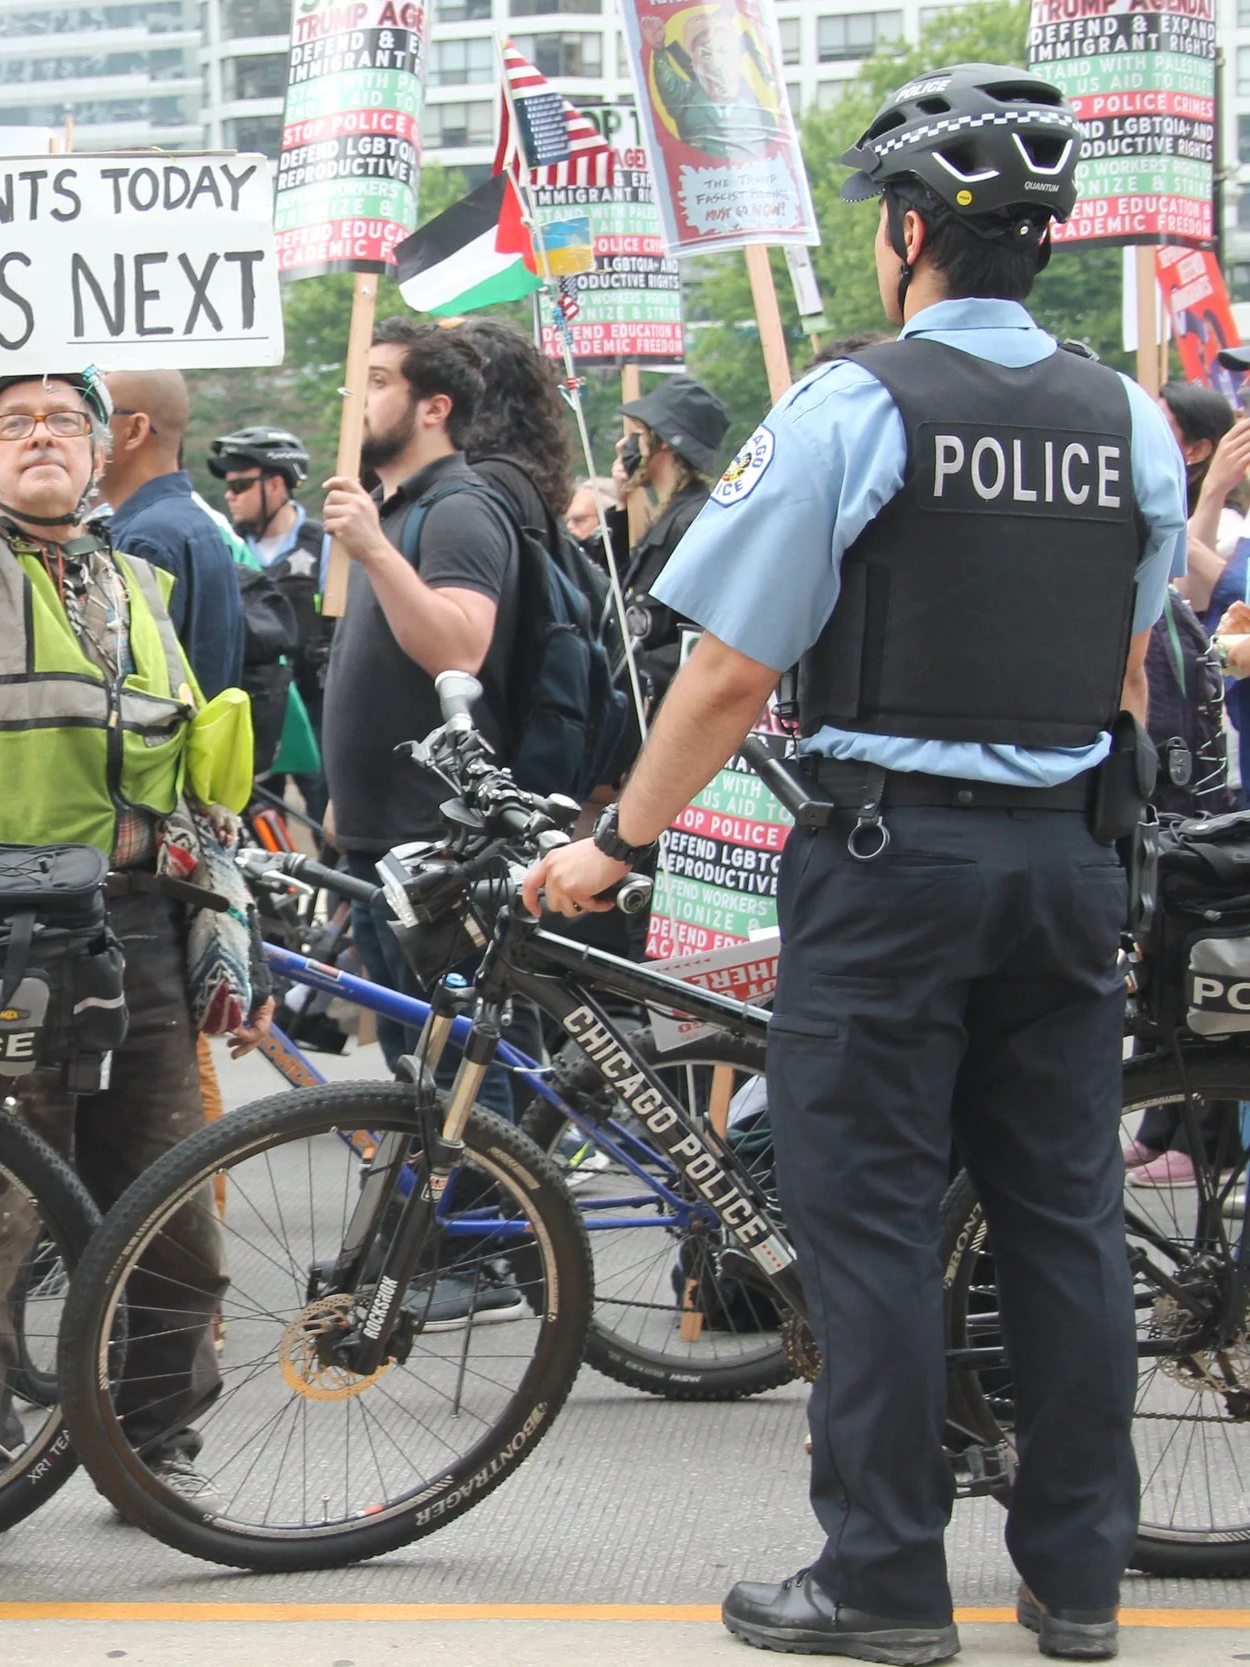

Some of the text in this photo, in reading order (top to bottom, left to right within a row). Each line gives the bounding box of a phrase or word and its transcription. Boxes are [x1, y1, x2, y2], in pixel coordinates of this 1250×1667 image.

[296, 3, 368, 43] TRUMP
[1031, 15, 1215, 46] DEFEND & EXPAND
[291, 30, 395, 66] DEFEND &
[1030, 33, 1216, 62] IMMIGRANT RIGHTS
[289, 50, 406, 85] IMMIGRANT
[1032, 55, 1214, 80] STAND WITH PALESTINE
[895, 80, 951, 102] POLICE
[1076, 77, 1100, 93] US
[1110, 73, 1143, 91] AID
[1151, 72, 1173, 88] TO
[1093, 94, 1167, 114] POLICE
[1173, 96, 1213, 117] CRIMES
[283, 112, 407, 147] STOP POLICE
[1112, 116, 1192, 136] LGBTQIA+
[1193, 122, 1214, 141] AND
[280, 140, 339, 171] DEFEND
[1177, 138, 1213, 160] RIGHTS
[278, 157, 410, 191] REPRODUCTIVE
[703, 179, 731, 188] THE
[1024, 181, 1059, 192] QUANTUM
[101, 165, 257, 214] TODAY
[696, 190, 747, 205] FASCIST
[705, 206, 732, 221] MUST
[1117, 197, 1200, 216] EDUCATION
[1157, 214, 1212, 238] FREEDOM
[71, 250, 265, 338] NEXT
[610, 324, 672, 338] EDUCATION
[636, 339, 683, 354] FREEDOM
[933, 435, 1120, 508] POLICE
[722, 774, 763, 799] WITH
[702, 790, 721, 809] US
[726, 796, 755, 817] AID
[710, 815, 779, 846] POLICE
[660, 829, 716, 860] DEFEND
[563, 1006, 678, 1134] CHICAGO
[669, 1132, 768, 1244] POLICE
[414, 1415, 539, 1526] BONTRAGER
